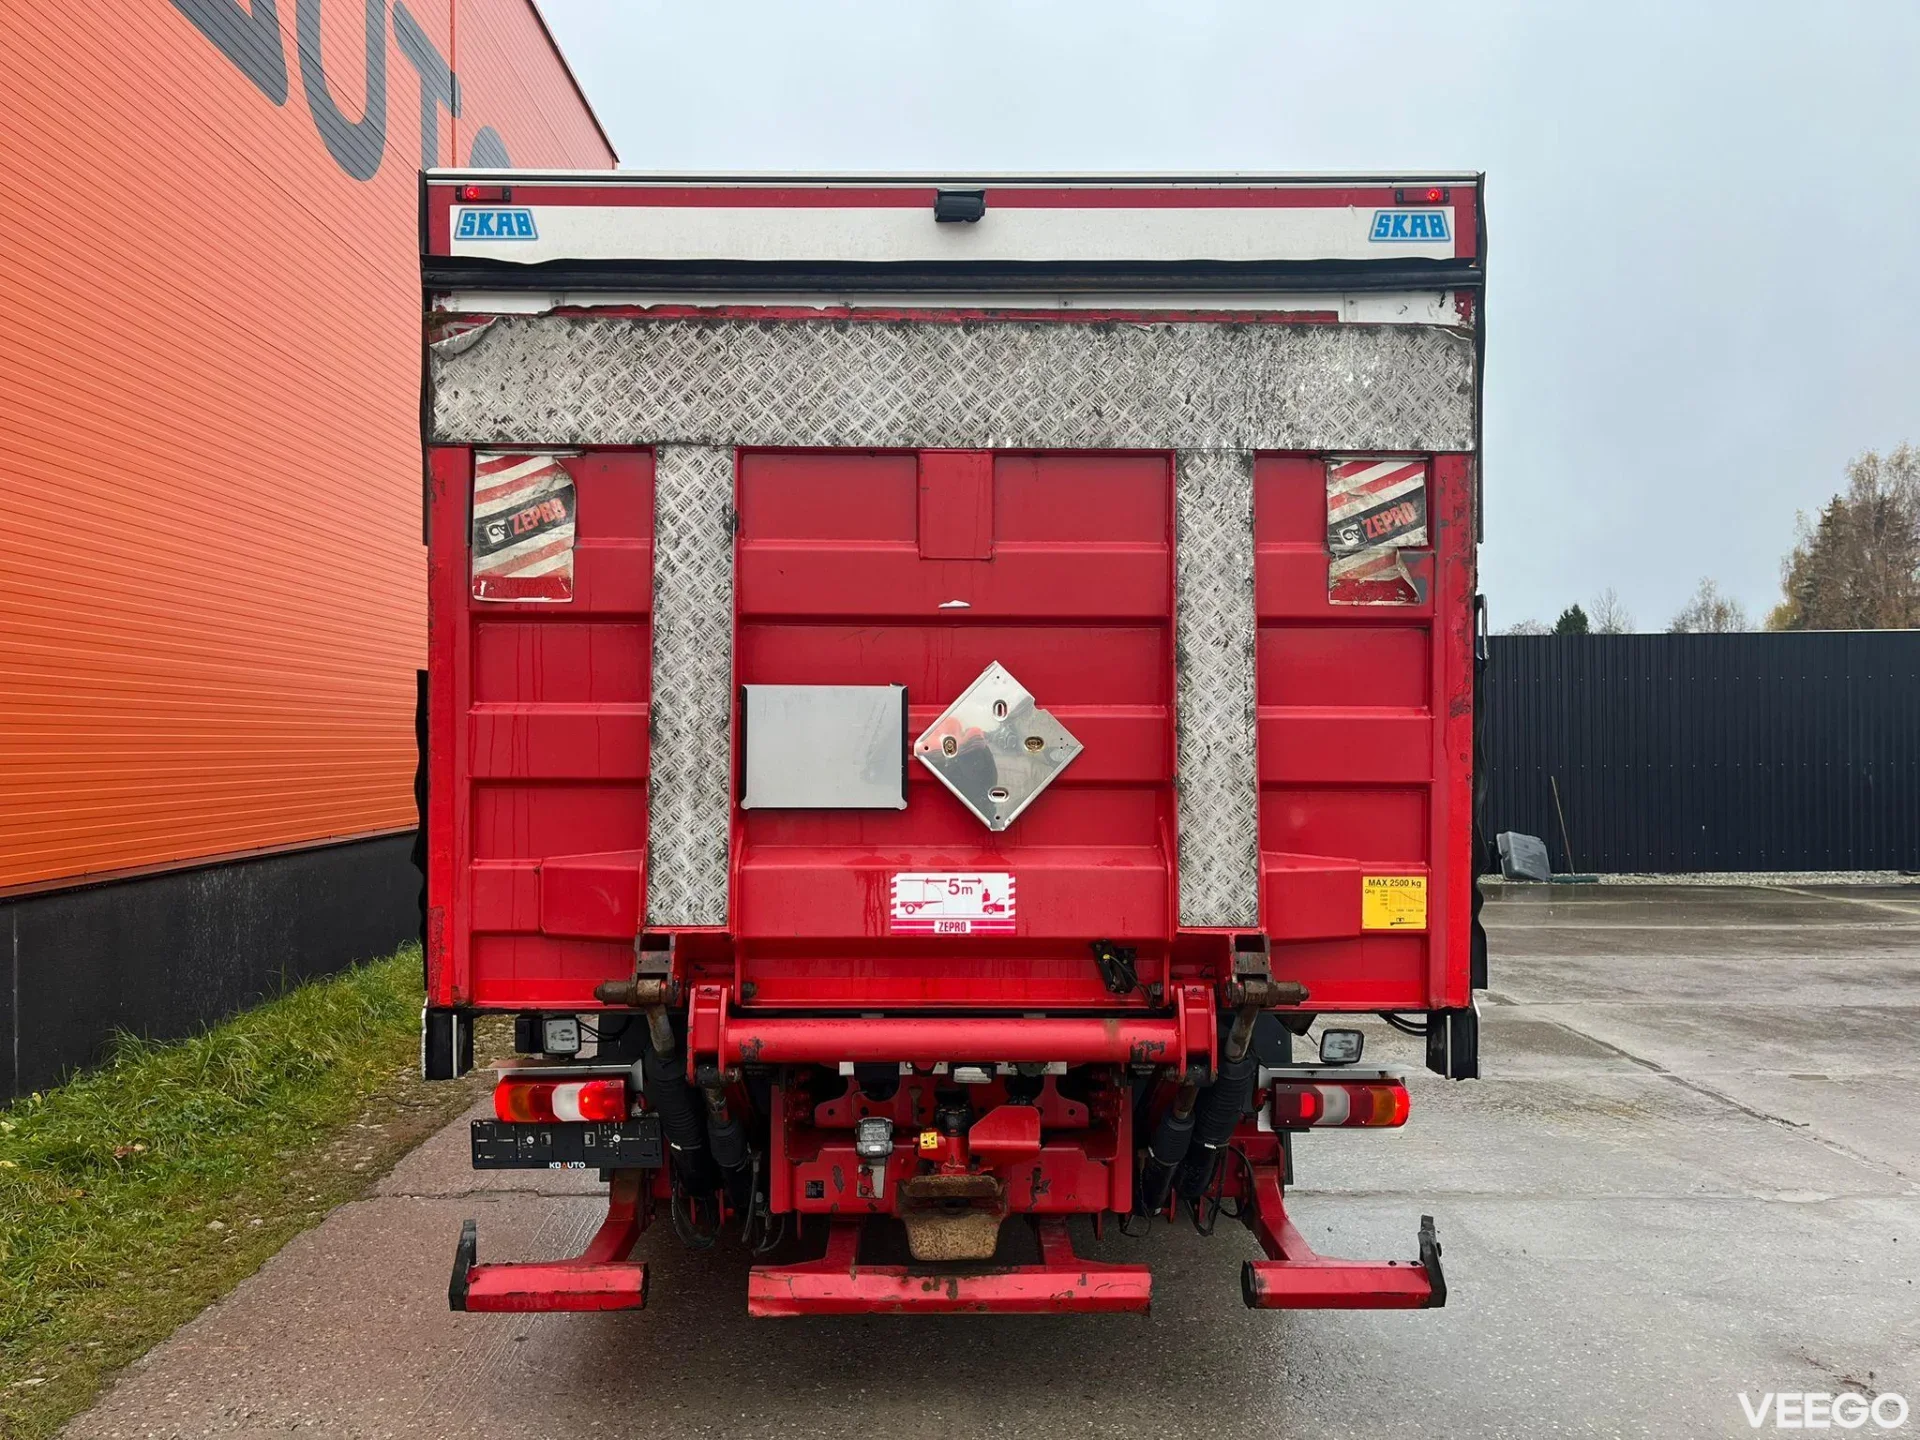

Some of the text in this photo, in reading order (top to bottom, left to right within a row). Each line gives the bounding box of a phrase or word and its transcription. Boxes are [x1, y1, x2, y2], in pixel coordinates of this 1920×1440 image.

[460, 212, 533, 236] SKAB
[1374, 214, 1446, 238] SKAB
[508, 498, 567, 535] ZEPRO
[1361, 502, 1417, 539] ZEPRO
[1411, 879, 1422, 888] kg
[938, 921, 967, 932] ZEPRO
